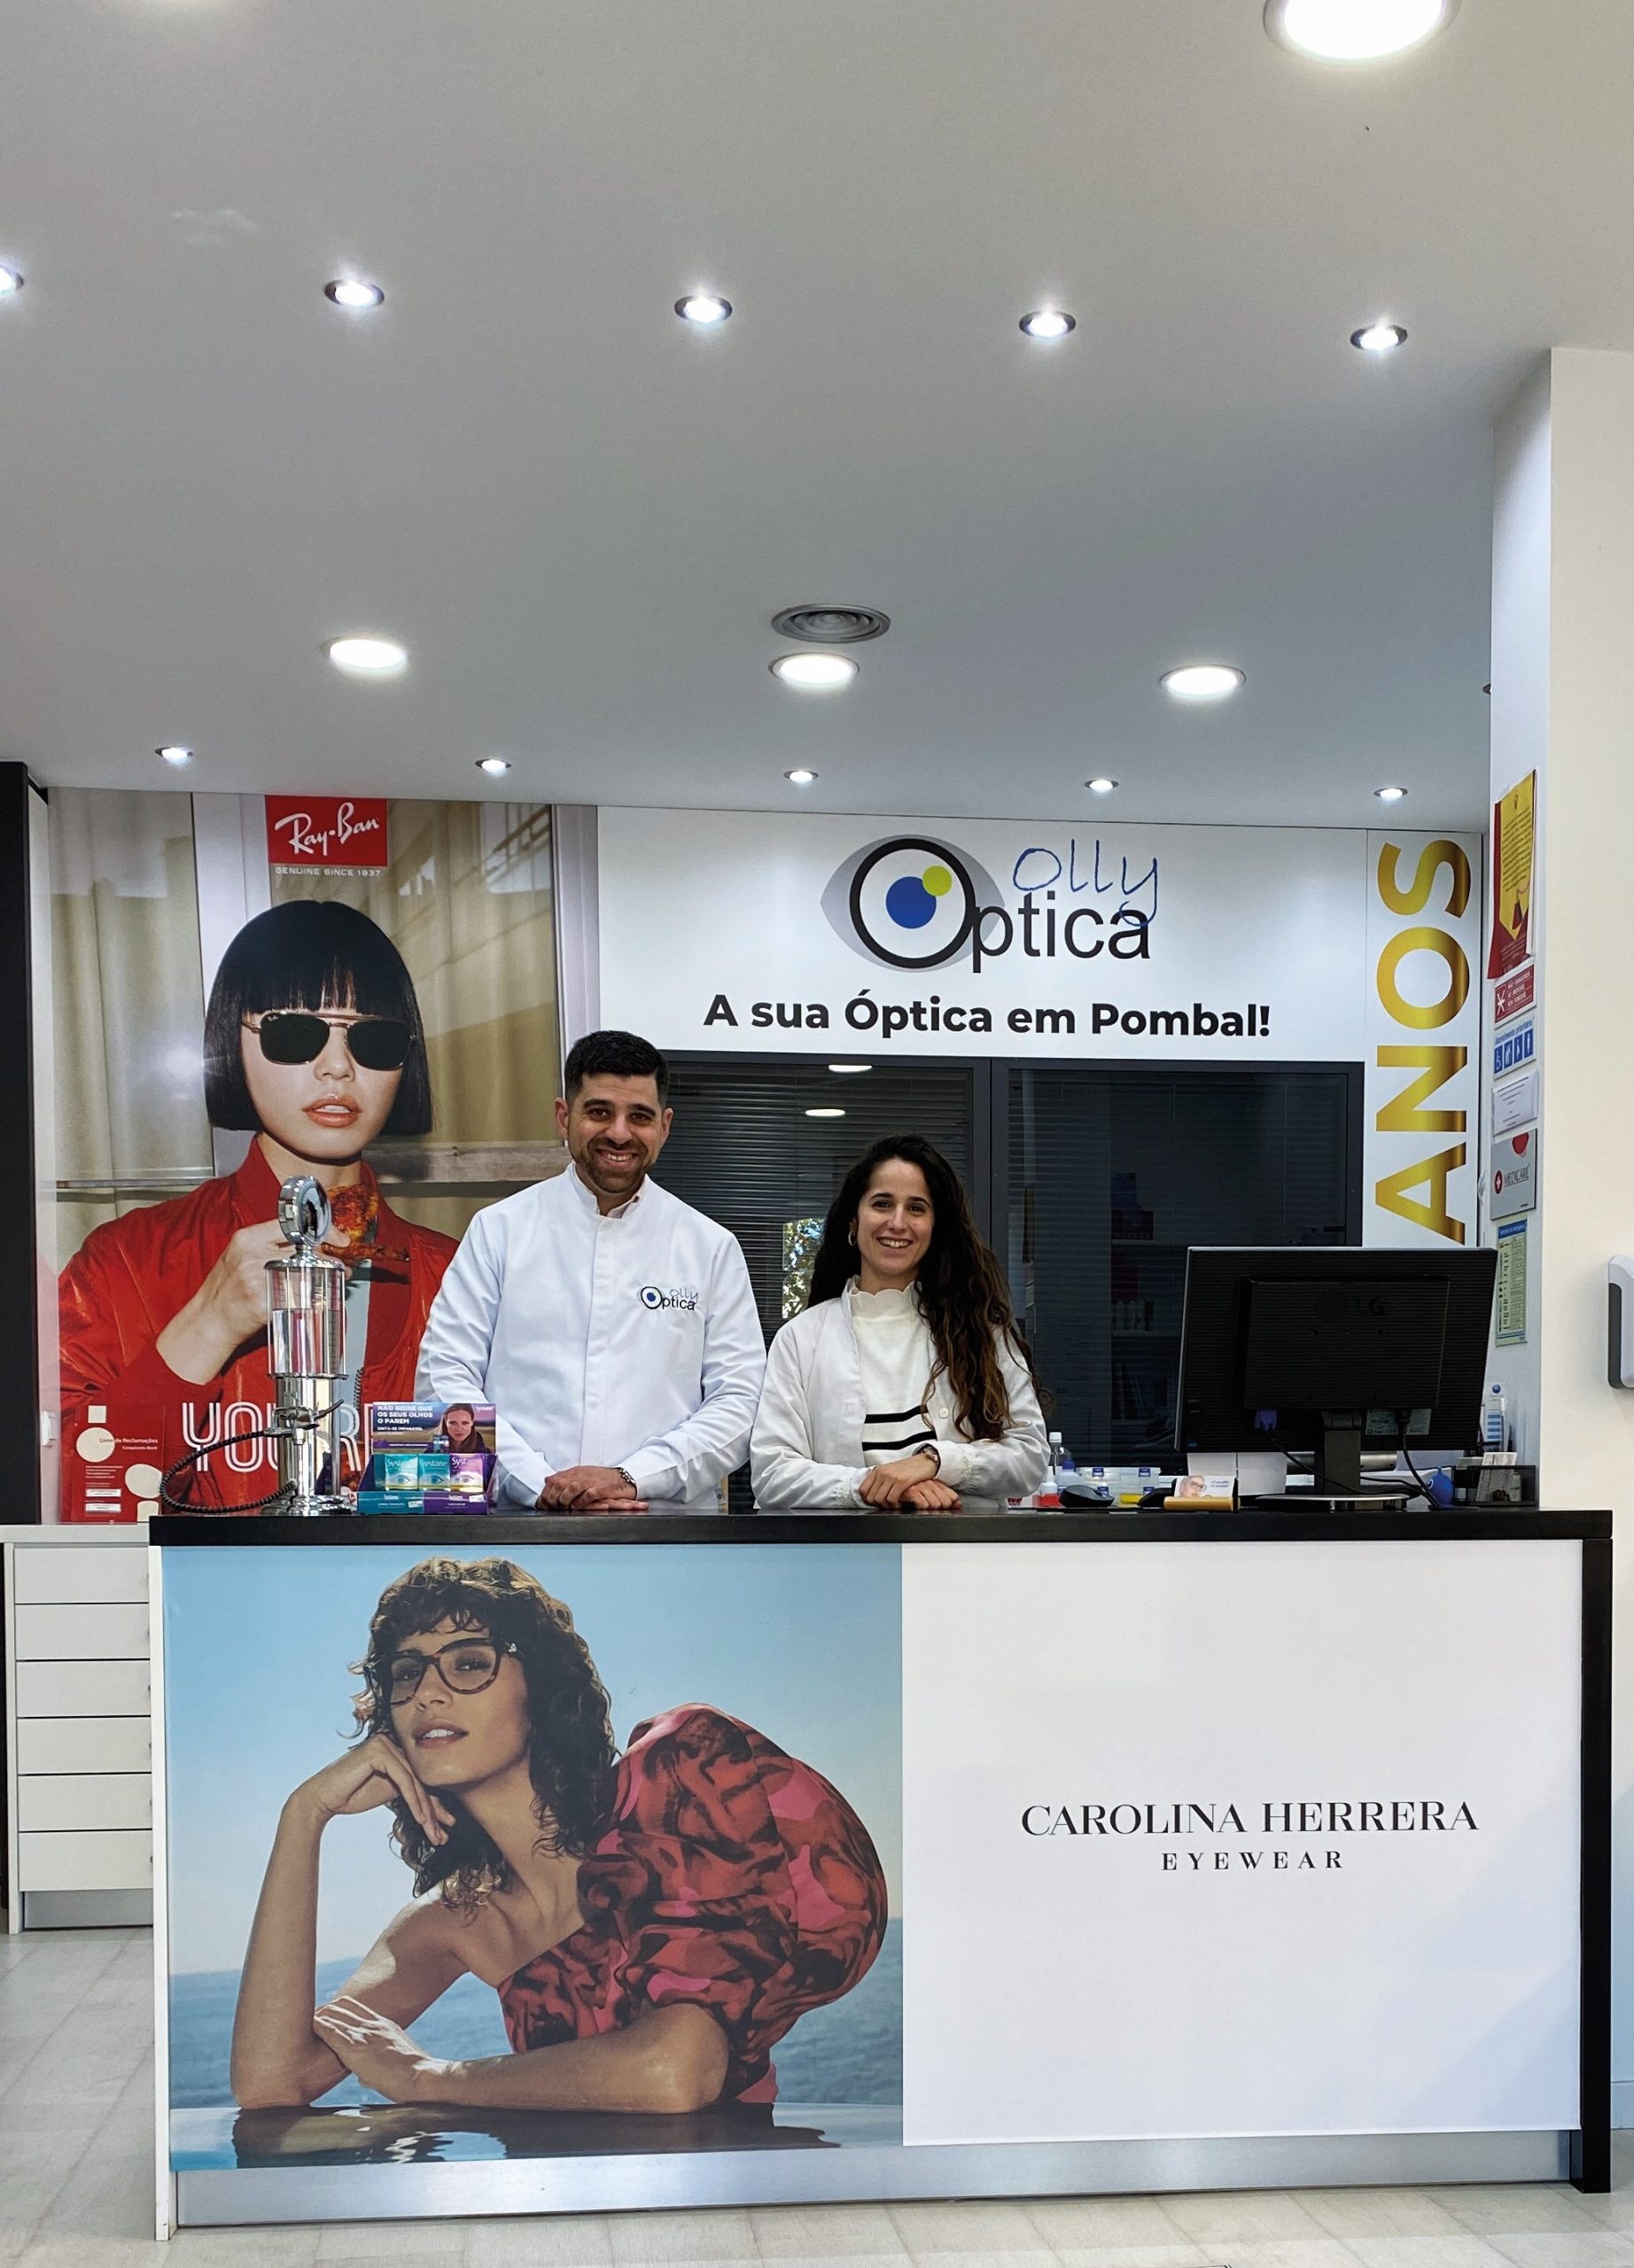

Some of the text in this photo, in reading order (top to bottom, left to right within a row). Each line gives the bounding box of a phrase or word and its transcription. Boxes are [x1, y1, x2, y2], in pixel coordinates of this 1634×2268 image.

[274, 802, 380, 857] Ray-Ban
[275, 866, 320, 875] GENUINE
[1014, 839, 1159, 926] olly
[703, 989, 1270, 1039] A sua Óptica em Pombal!
[1375, 840, 1471, 1246] ANOS
[1021, 1801, 1479, 1836] CAROLINA HERRERA
[1162, 1851, 1343, 1871] EYEWEAR
